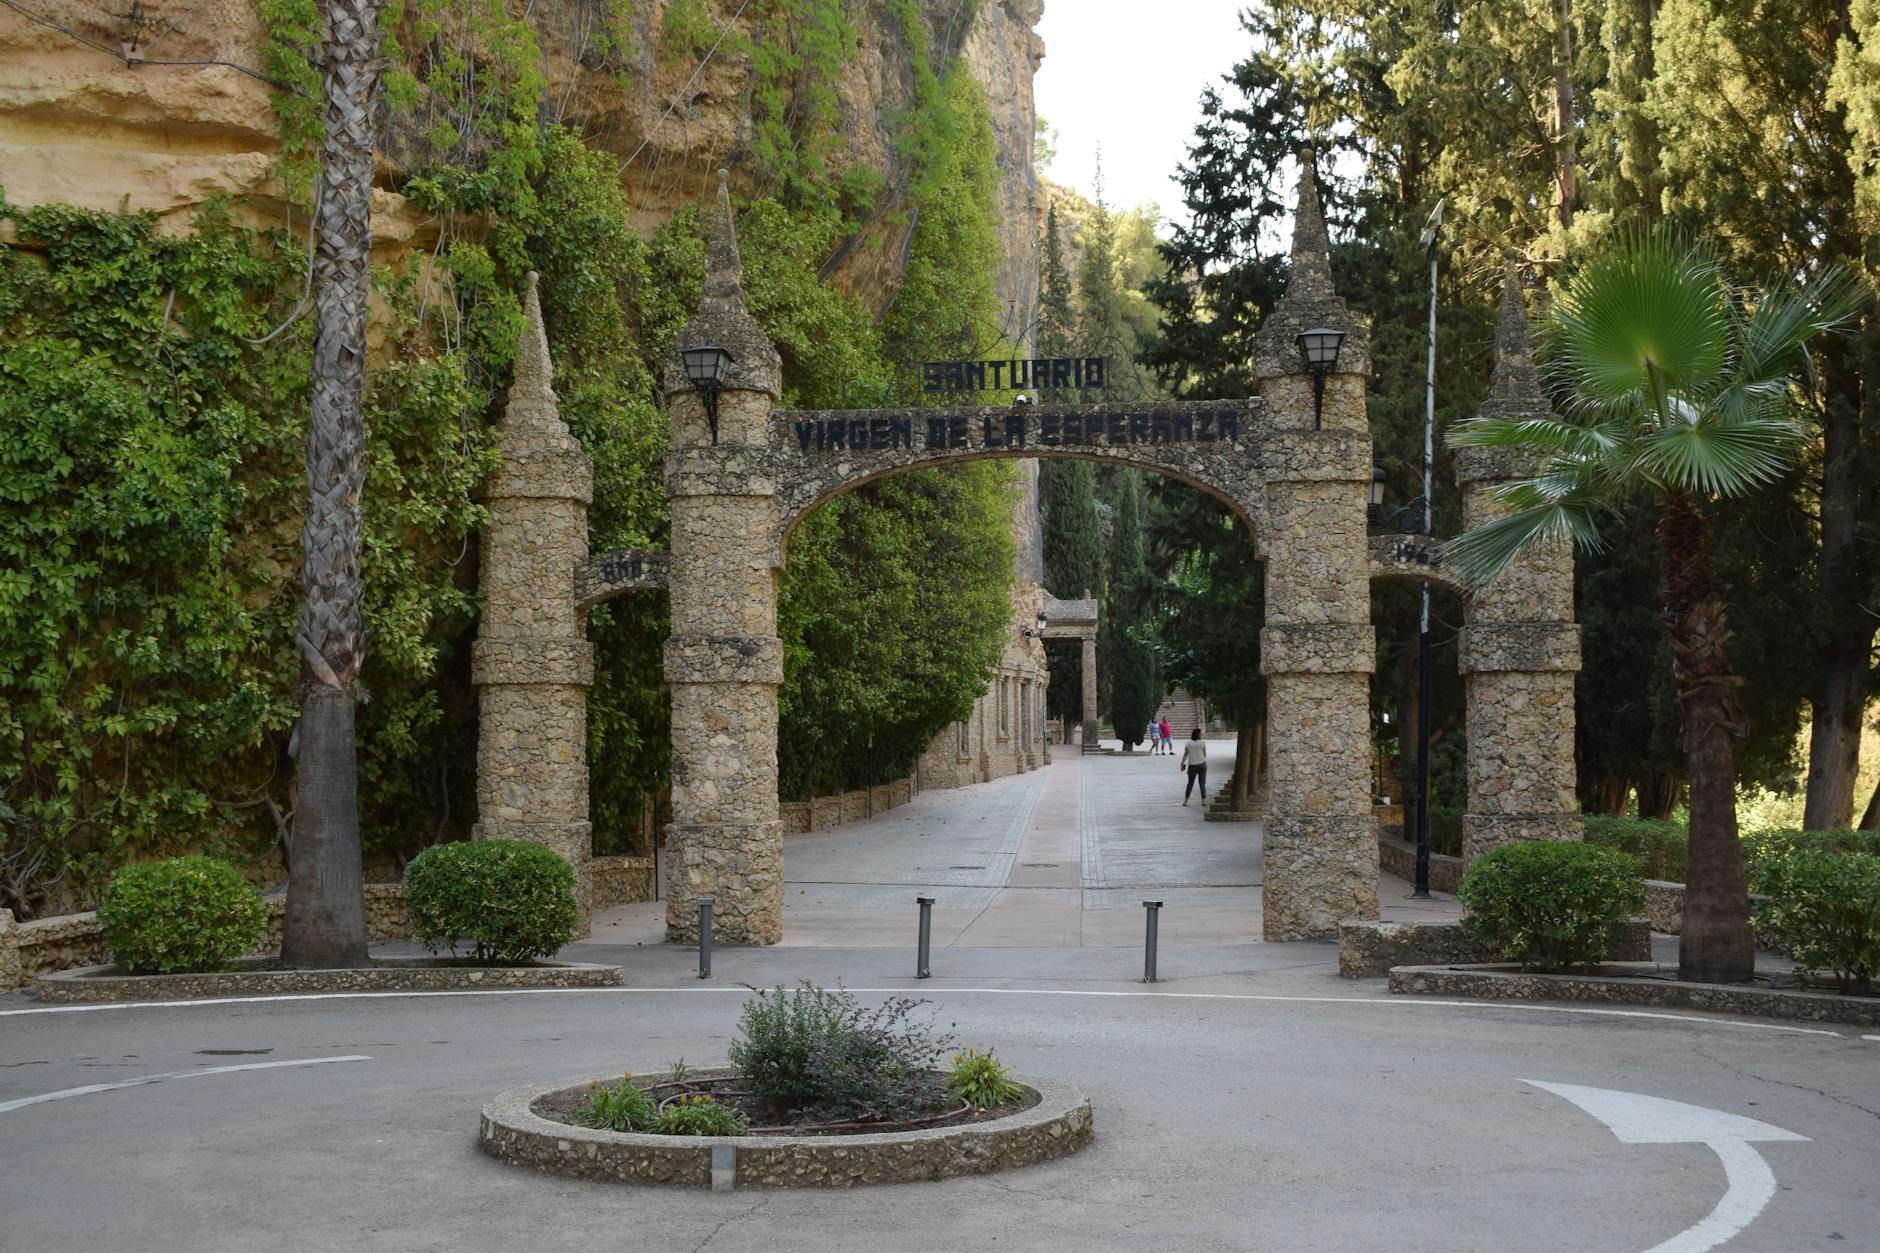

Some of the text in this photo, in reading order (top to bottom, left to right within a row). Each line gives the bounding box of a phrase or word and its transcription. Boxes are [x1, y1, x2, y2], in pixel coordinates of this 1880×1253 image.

[923, 360, 1103, 390] SANTUARIO
[797, 412, 1238, 450] VIRGEN DE LA ESPERANZA
